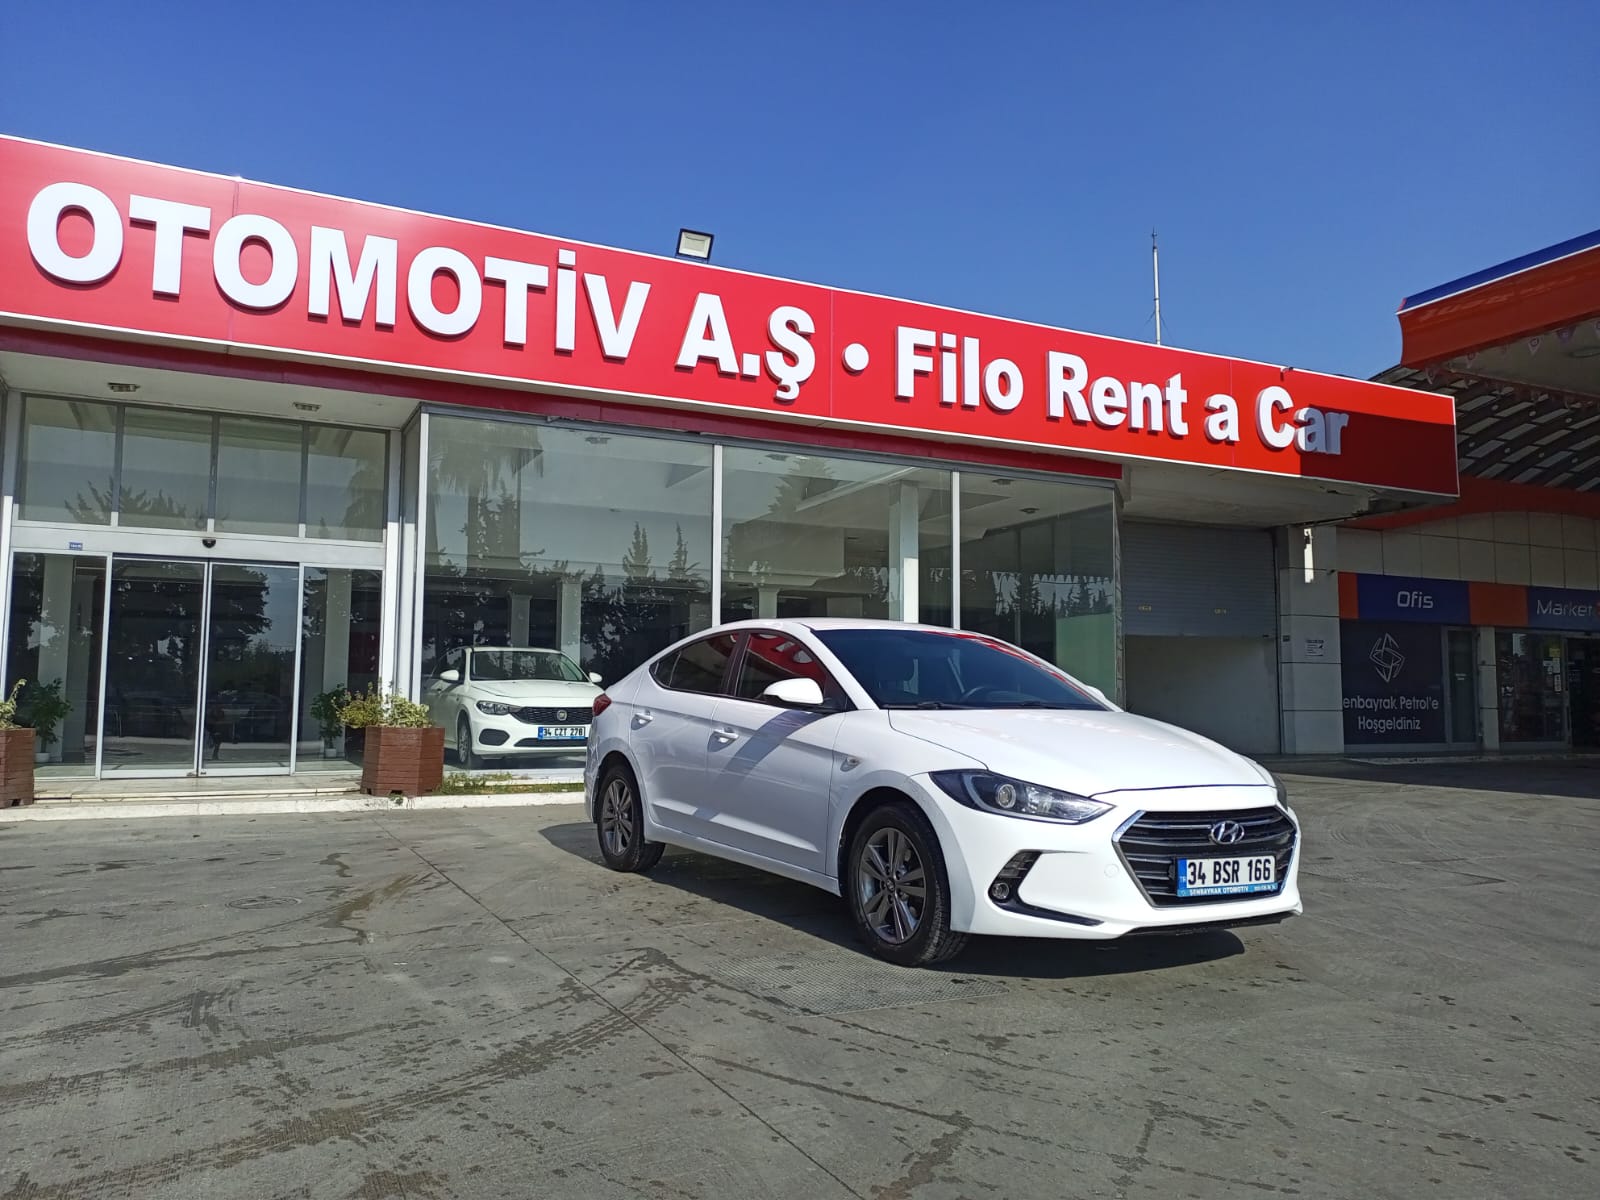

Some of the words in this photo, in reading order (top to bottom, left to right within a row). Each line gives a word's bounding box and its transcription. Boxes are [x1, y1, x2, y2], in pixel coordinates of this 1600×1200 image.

[27, 181, 651, 358] OTOMOTİV
[677, 292, 815, 402] A.Ş
[896, 326, 1024, 412] Filo
[1047, 351, 1189, 437] Rent
[1205, 394, 1240, 443] a
[1257, 386, 1350, 456] Car
[1397, 591, 1434, 609] Ofis
[1536, 599, 1593, 617] Market
[1342, 695, 1398, 712] enbayrak
[543, 728, 552, 736] 34
[1357, 716, 1421, 733] Hoşgeldiniz
[1187, 861, 1206, 885] 34
[1212, 860, 1240, 884] BSR
[1247, 858, 1271, 881] 166
